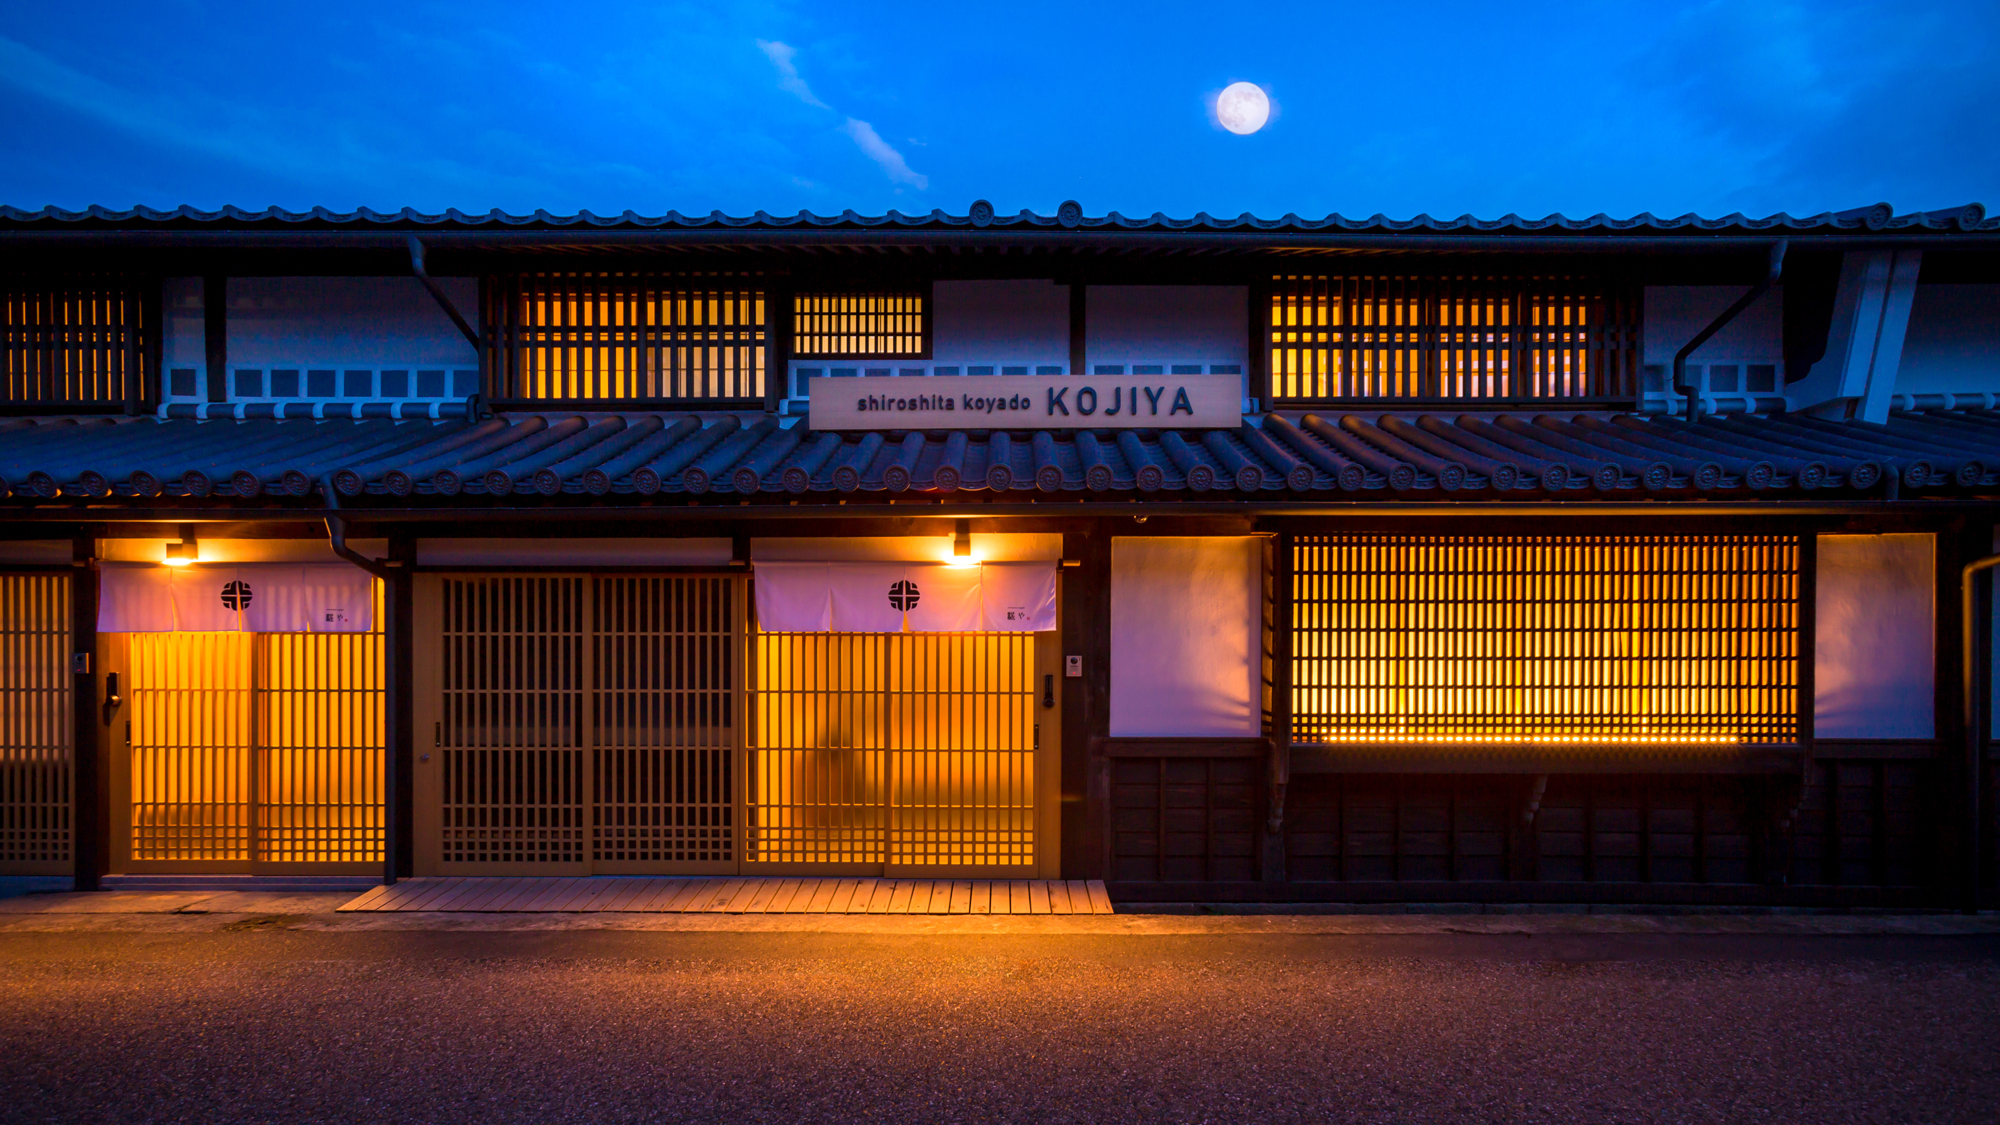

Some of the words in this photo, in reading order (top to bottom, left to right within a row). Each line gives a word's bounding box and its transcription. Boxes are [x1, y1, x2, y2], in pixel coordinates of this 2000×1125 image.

[857, 394, 955, 411] shiroshita
[963, 393, 1031, 414] koyado
[1047, 386, 1194, 416] KOJIYA
